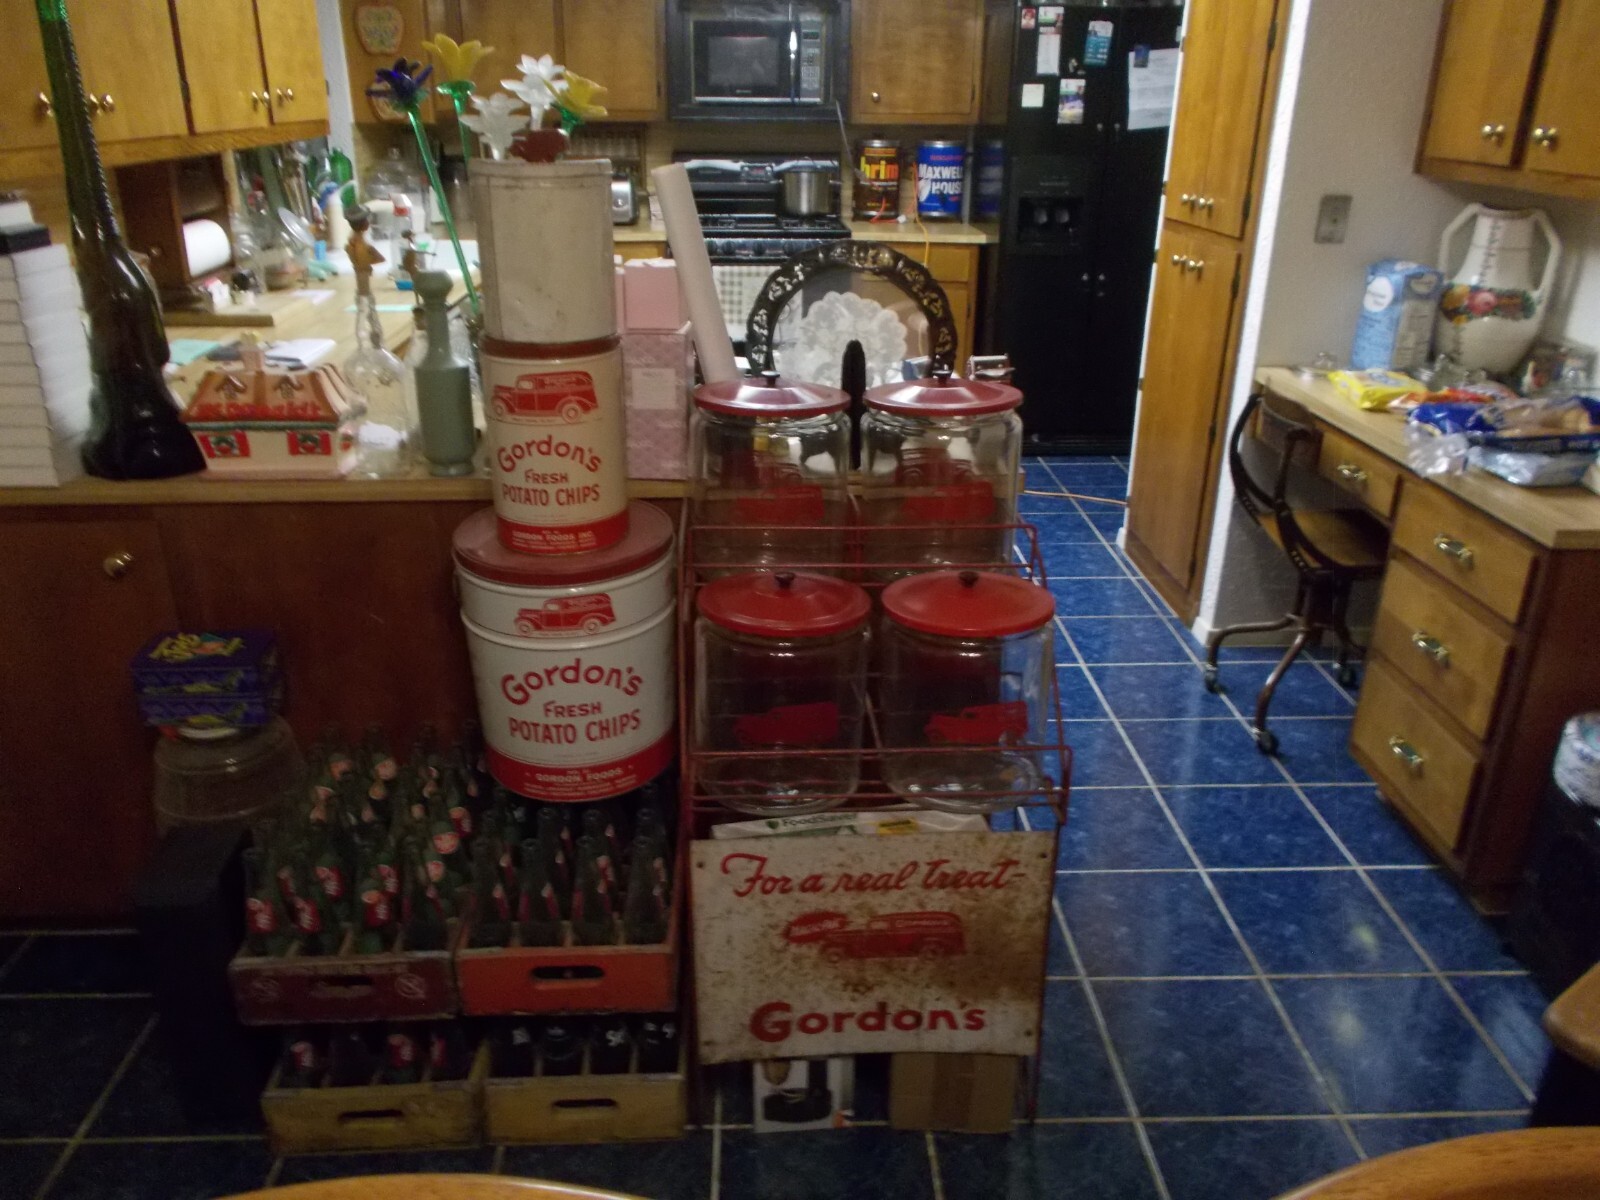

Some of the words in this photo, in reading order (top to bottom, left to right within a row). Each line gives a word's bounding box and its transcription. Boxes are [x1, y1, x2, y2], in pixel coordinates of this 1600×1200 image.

[860, 156, 899, 179] brim
[497, 435, 602, 473] Gordon's
[524, 469, 569, 484] FRESH
[502, 484, 549, 506] POTATO
[555, 484, 600, 506] CHIPS
[501, 658, 643, 705] Gordon's
[508, 716, 577, 744] POTATO
[585, 709, 641, 742] CHIPS
[543, 700, 602, 718] FRESH
[720, 853, 793, 897] For
[799, 875, 824, 894] a
[831, 861, 918, 894] real
[750, 1001, 986, 1042] Gordon's
